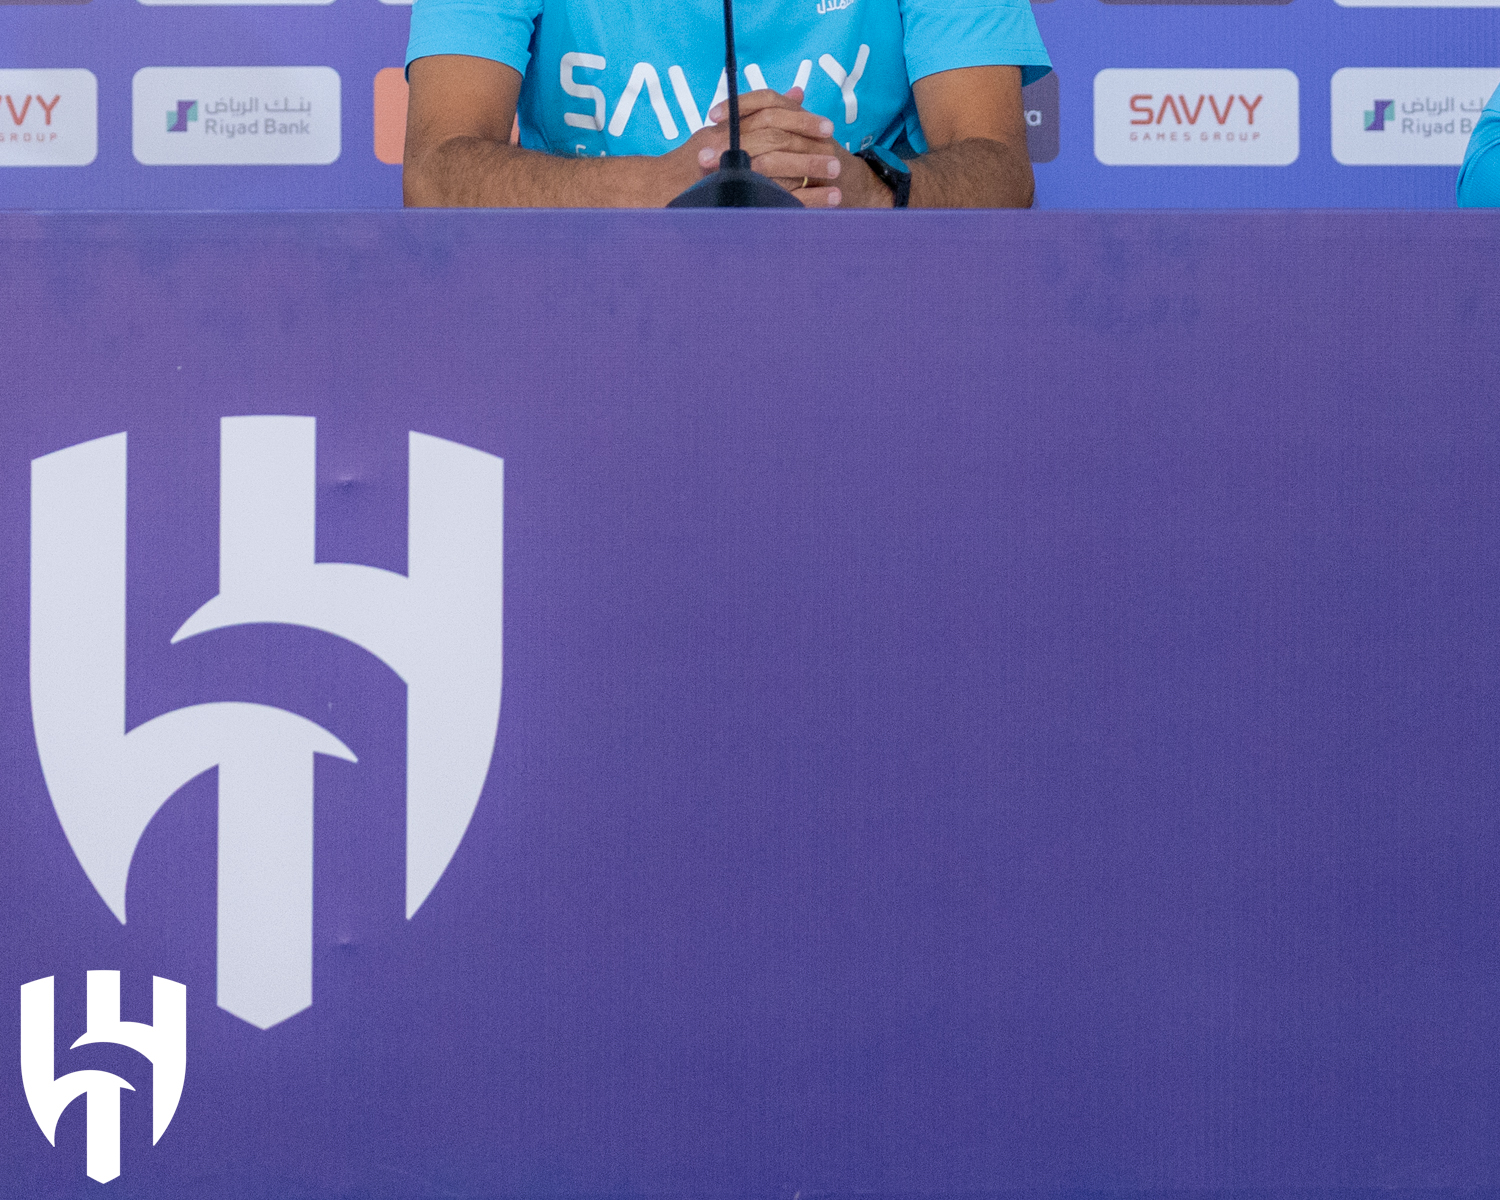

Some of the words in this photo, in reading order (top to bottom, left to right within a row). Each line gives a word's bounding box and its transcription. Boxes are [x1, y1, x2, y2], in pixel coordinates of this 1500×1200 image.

[1129, 94, 1263, 126] SAVVY
[205, 118, 259, 138] Riyad
[265, 118, 310, 135] Bank
[1130, 131, 1191, 141] GAMES
[1201, 131, 1262, 141] GROUP
[1402, 118, 1455, 137] Riyad
